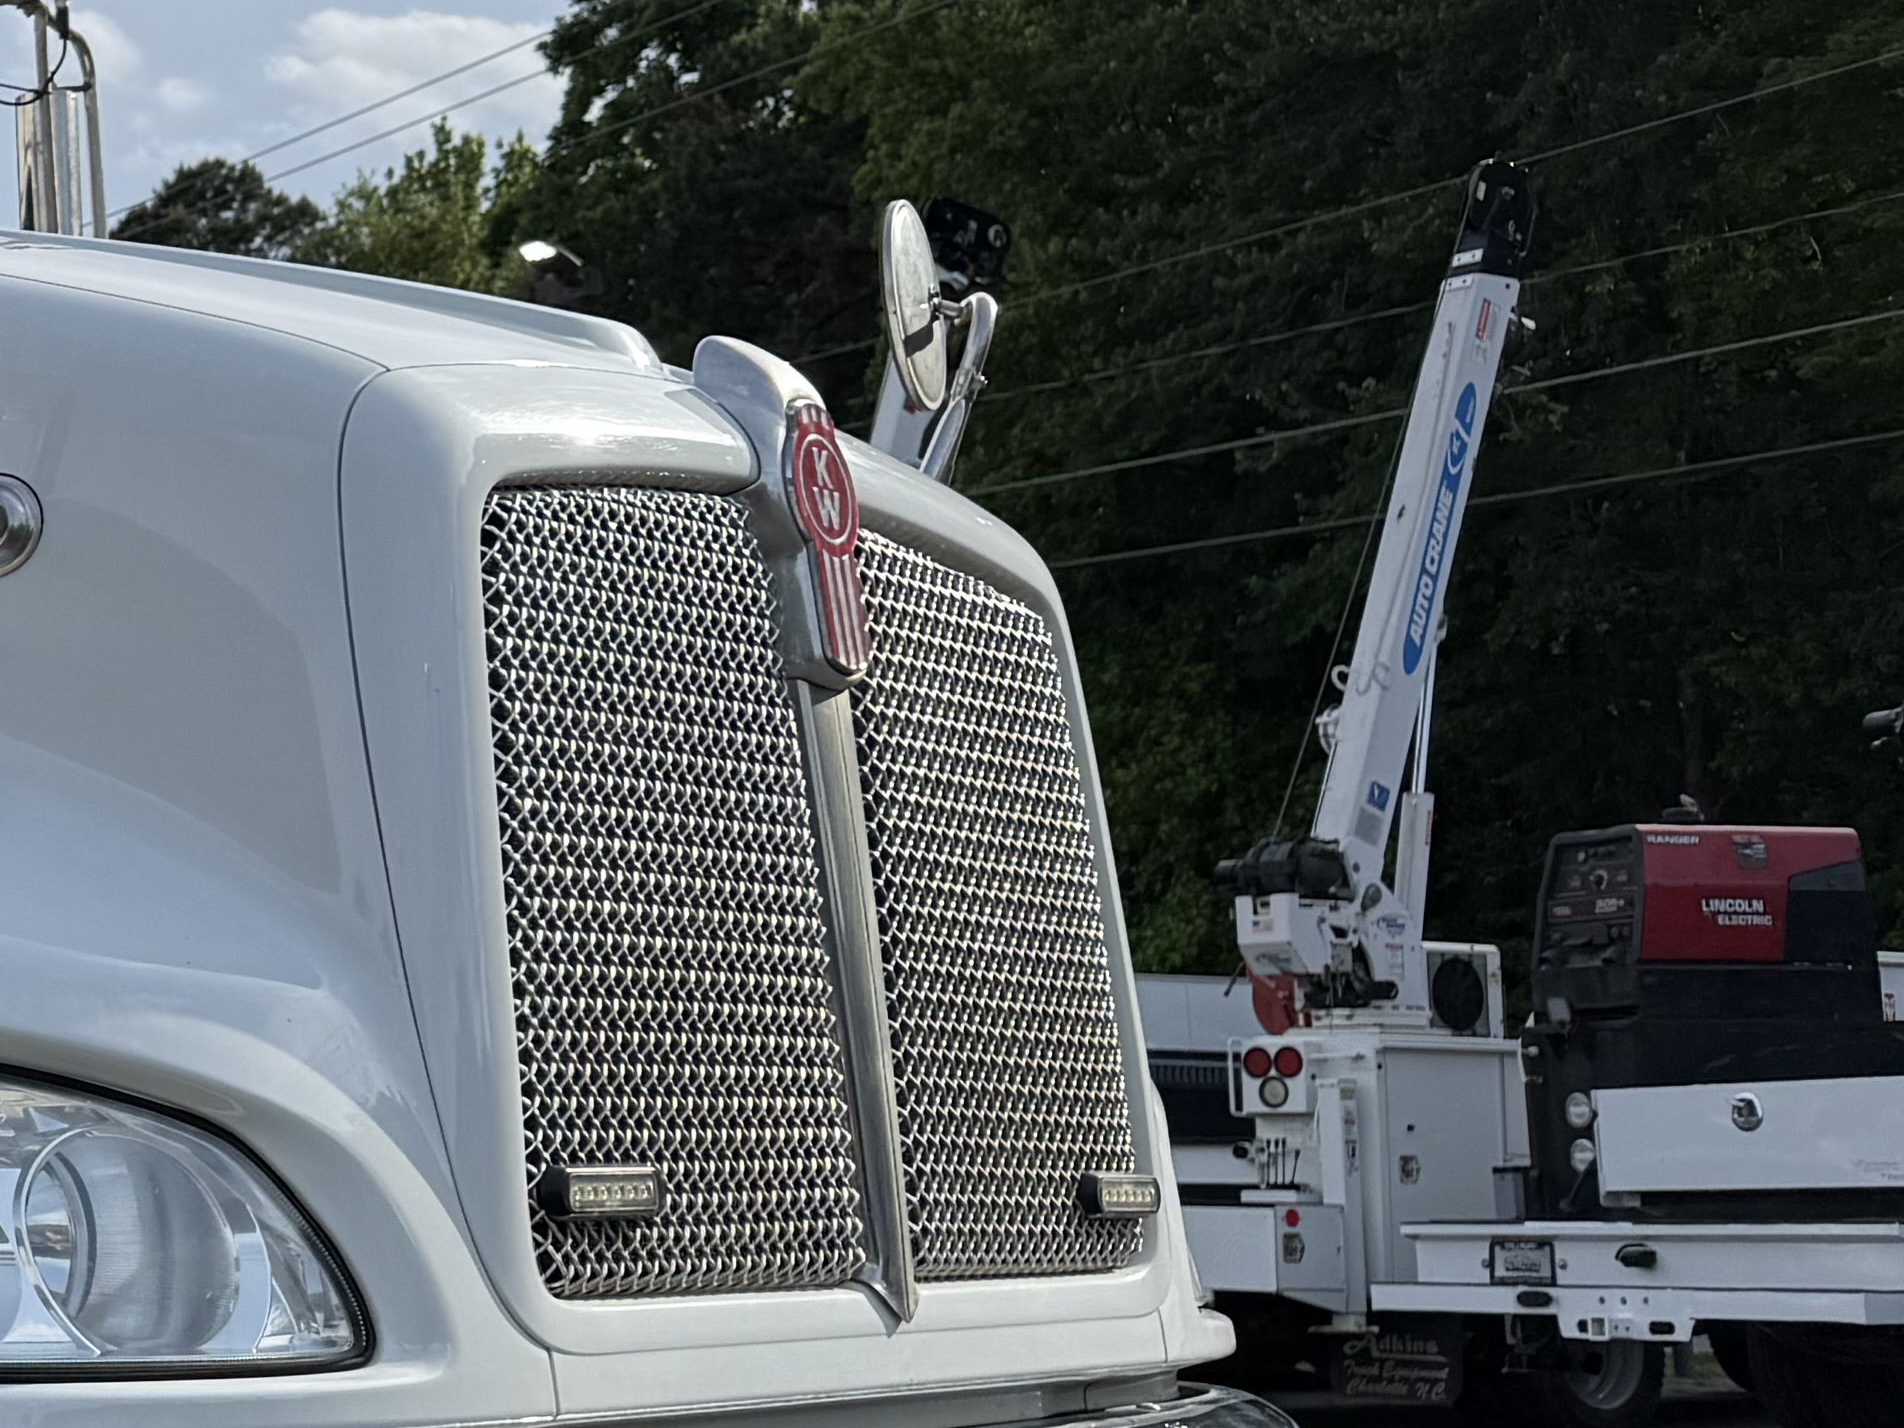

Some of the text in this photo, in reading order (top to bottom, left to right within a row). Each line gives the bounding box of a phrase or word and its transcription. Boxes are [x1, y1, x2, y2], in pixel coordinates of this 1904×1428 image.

[1410, 573, 1434, 648] AUTO
[1425, 480, 1454, 575] CRANE
[1701, 898, 1765, 913] LINCOLN
[1717, 914, 1774, 927] ELECTRIC
